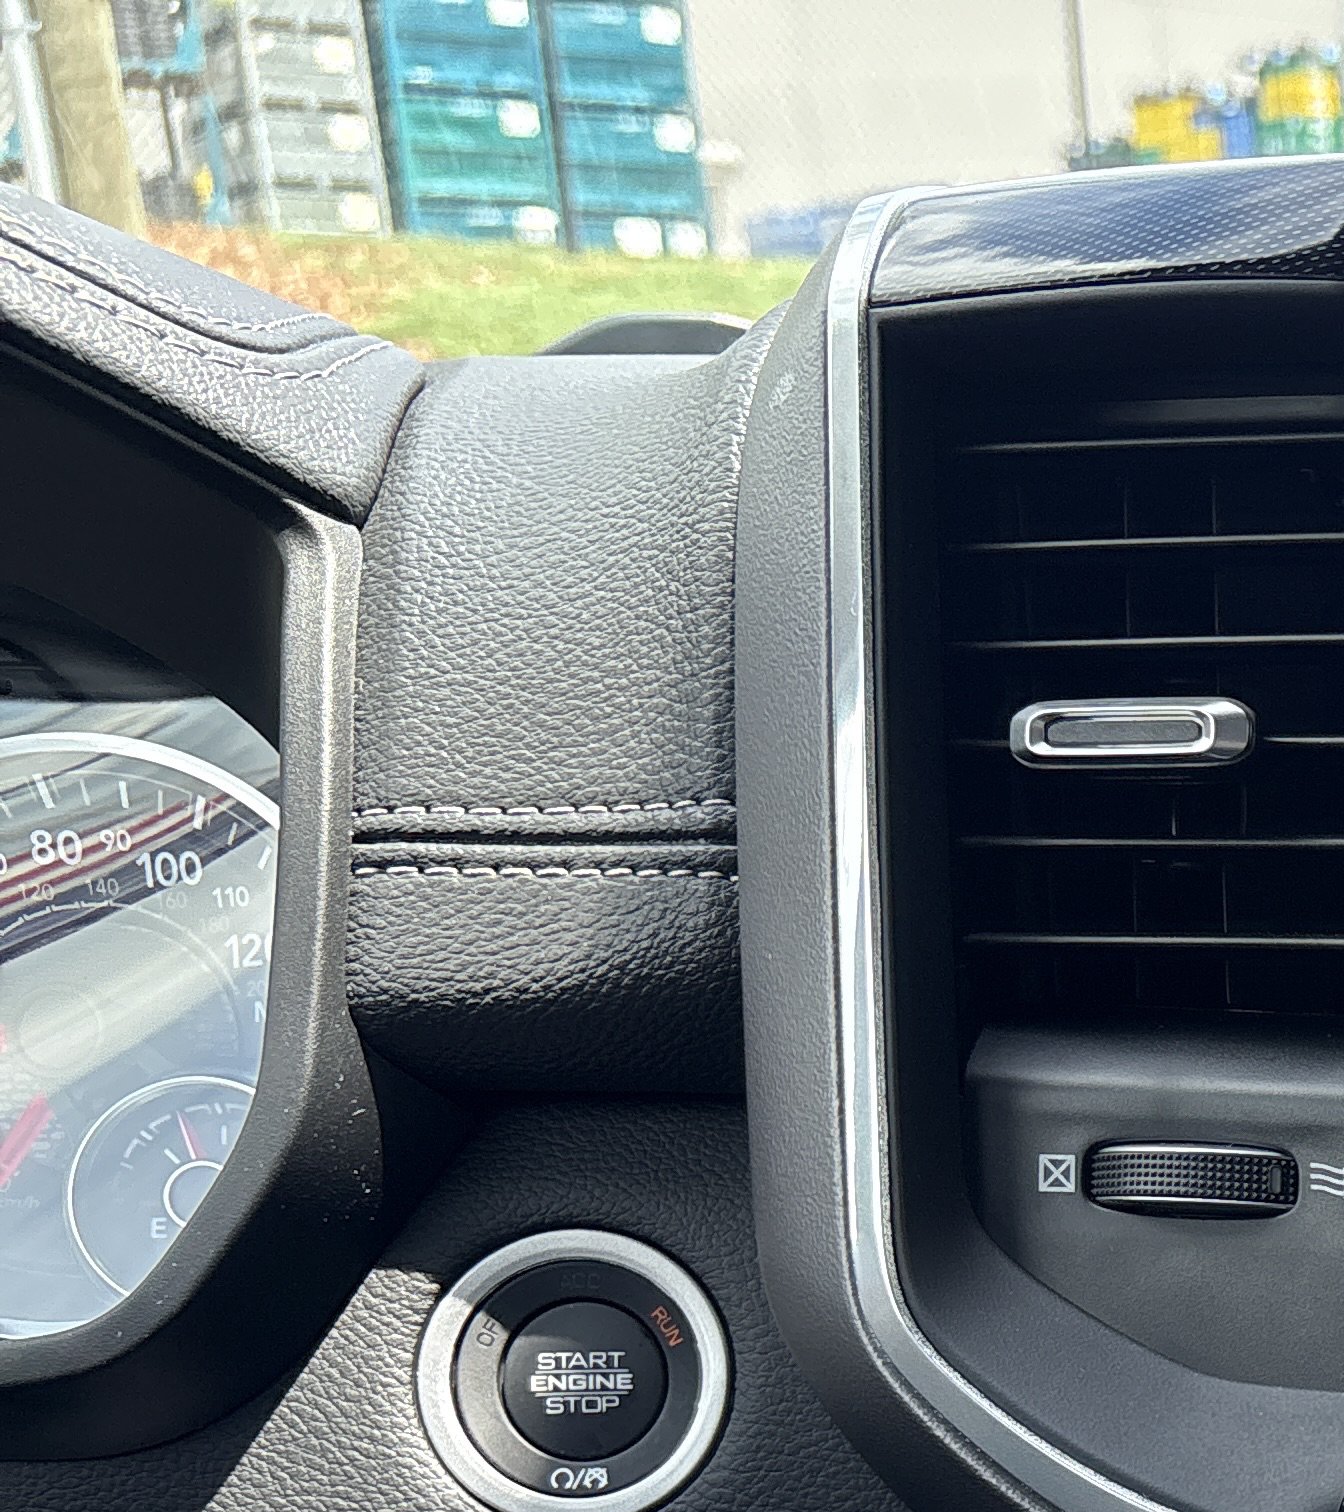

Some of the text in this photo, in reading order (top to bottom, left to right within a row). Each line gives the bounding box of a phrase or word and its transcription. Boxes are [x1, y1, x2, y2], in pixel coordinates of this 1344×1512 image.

[30, 829, 83, 865] 80
[100, 829, 132, 851] 90
[136, 851, 203, 888] 100
[18, 883, 55, 901] 120
[87, 878, 120, 896] 140
[212, 886, 249, 908] 110
[150, 1216, 168, 1239] E
[650, 1305, 684, 1348] RUN
[537, 1351, 626, 1370] START
[530, 1373, 634, 1393] ENGINE
[545, 1396, 620, 1415] STOP
